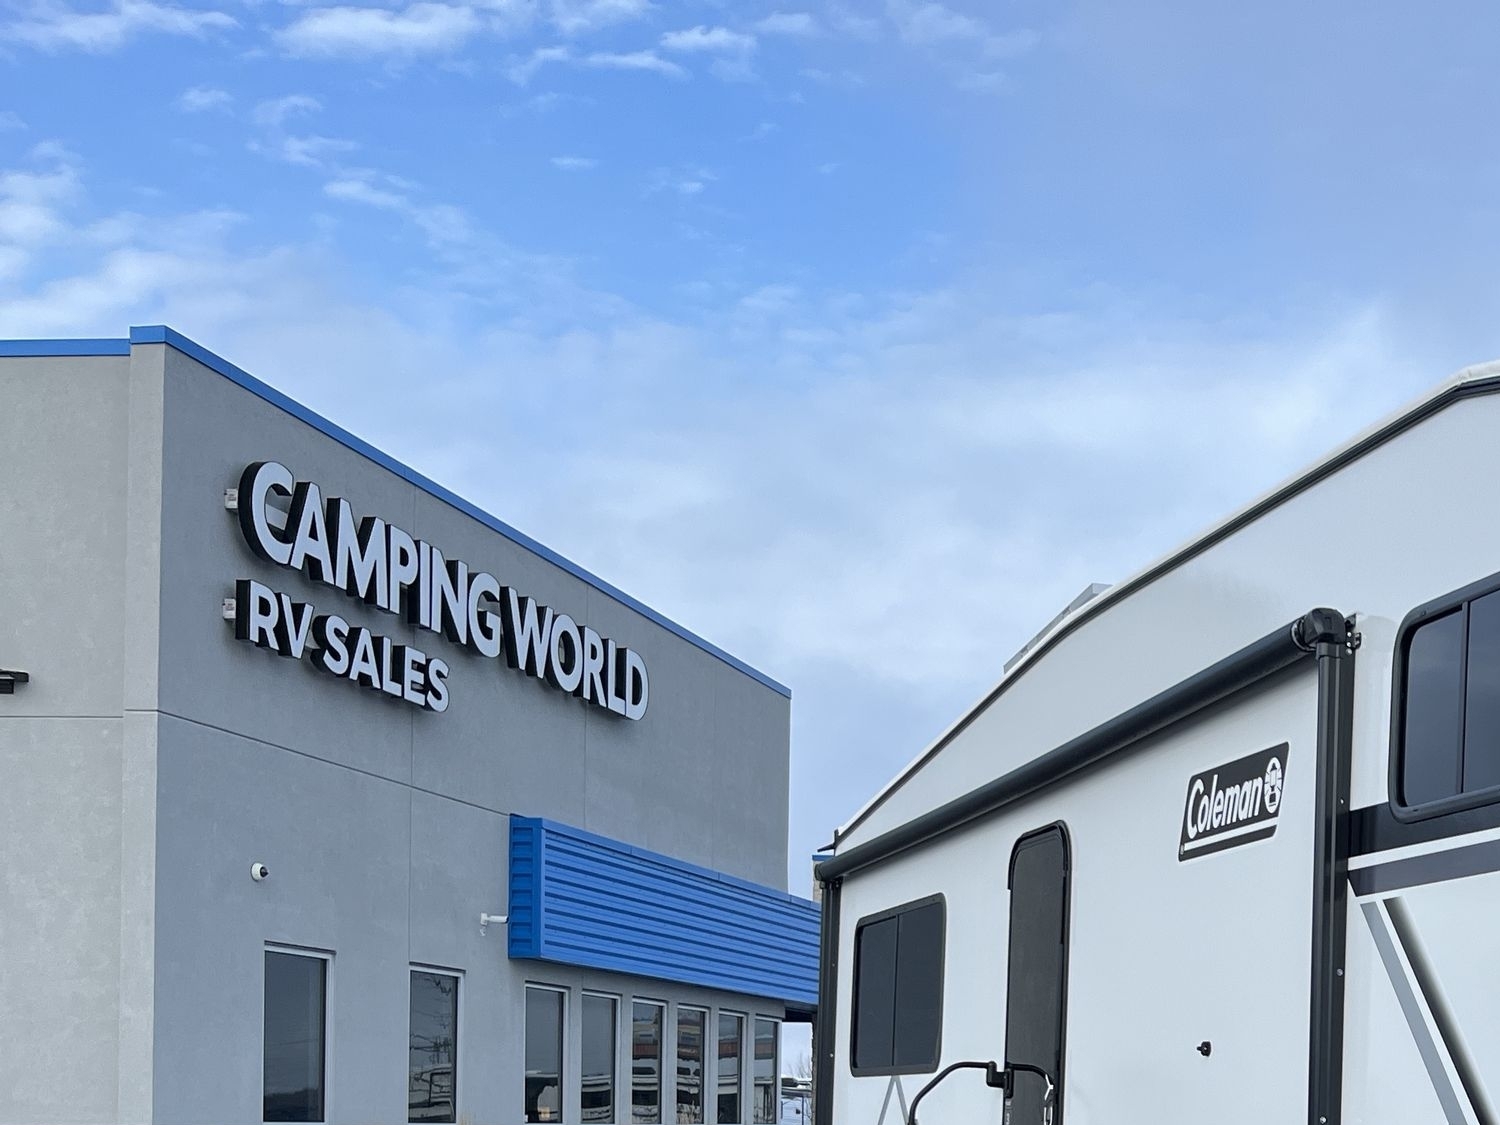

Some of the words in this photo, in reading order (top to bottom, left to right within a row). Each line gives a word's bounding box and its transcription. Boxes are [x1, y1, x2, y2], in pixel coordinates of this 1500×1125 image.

[240, 579, 315, 660] RV
[316, 613, 450, 713] SALES
[241, 460, 502, 658] CAMPING
[503, 586, 650, 721] WORLD
[1187, 774, 1263, 839] Coleman
